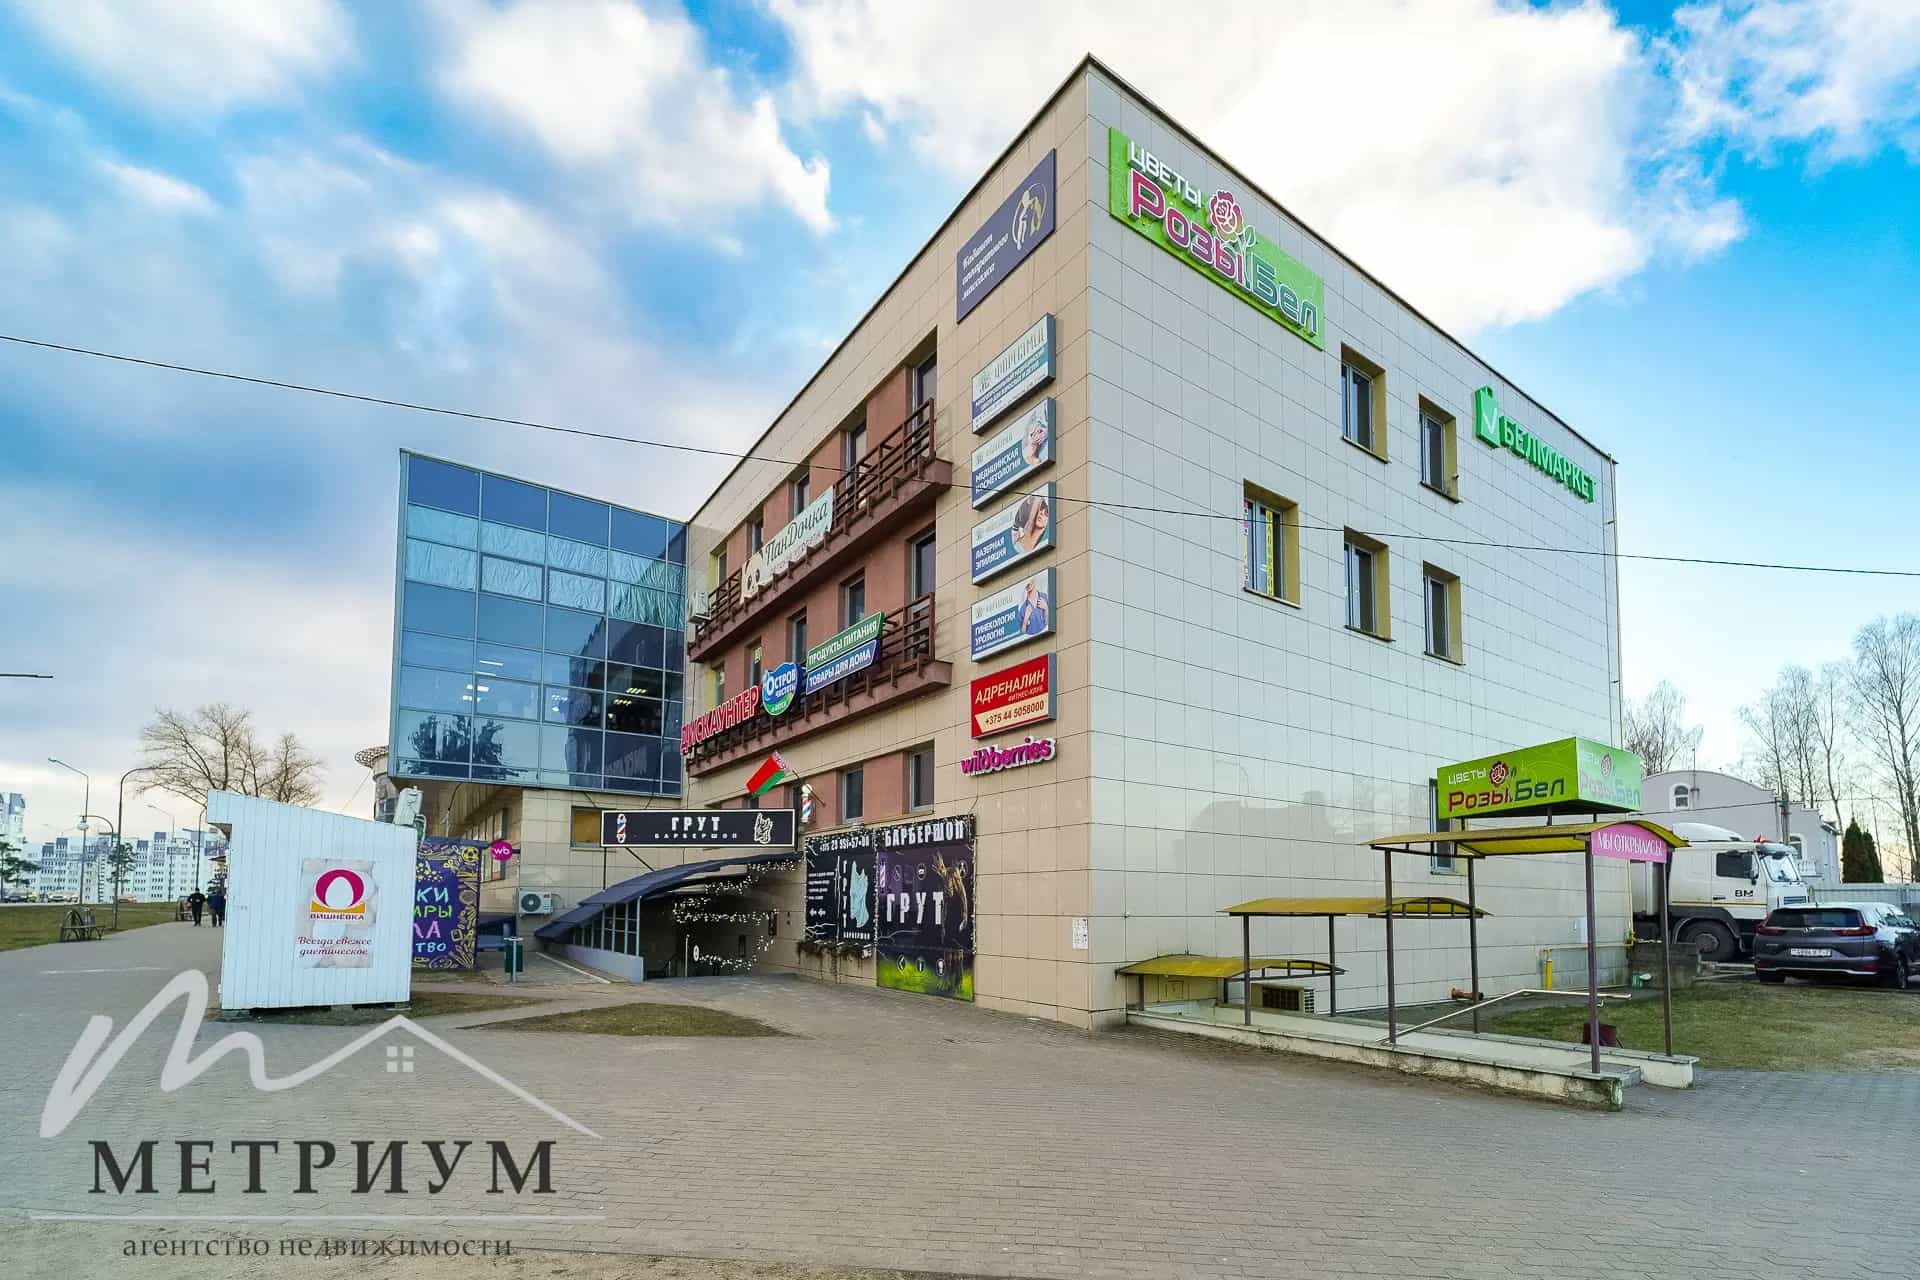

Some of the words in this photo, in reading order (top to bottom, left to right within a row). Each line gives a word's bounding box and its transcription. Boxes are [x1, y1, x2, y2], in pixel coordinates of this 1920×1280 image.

[1129, 140, 1202, 209] ЦВЕТЫ
[1499, 416, 1597, 503] БЕЛМАРКЕТ
[808, 639, 843, 665] ПРОДУКТЫ
[843, 620, 877, 649] ПИТАНИЯ
[809, 666, 834, 688] ТОВАРЫ
[848, 648, 871, 670] ДОМА
[975, 667, 1045, 704] АДРЕНАЛИН
[681, 686, 759, 756] ДИСКАУНТЕР
[985, 713, 1002, 726] +375
[1002, 709, 1012, 721] 44
[960, 736, 1057, 776] wildberries
[1448, 768, 1487, 785] ЦВЕТЫ
[671, 816, 720, 832] ГРУТ
[885, 820, 965, 847] БАРБЕРШОП
[1598, 831, 1612, 849] МЫ
[494, 847, 510, 855] wb
[886, 891, 944, 925] ГРУТ
